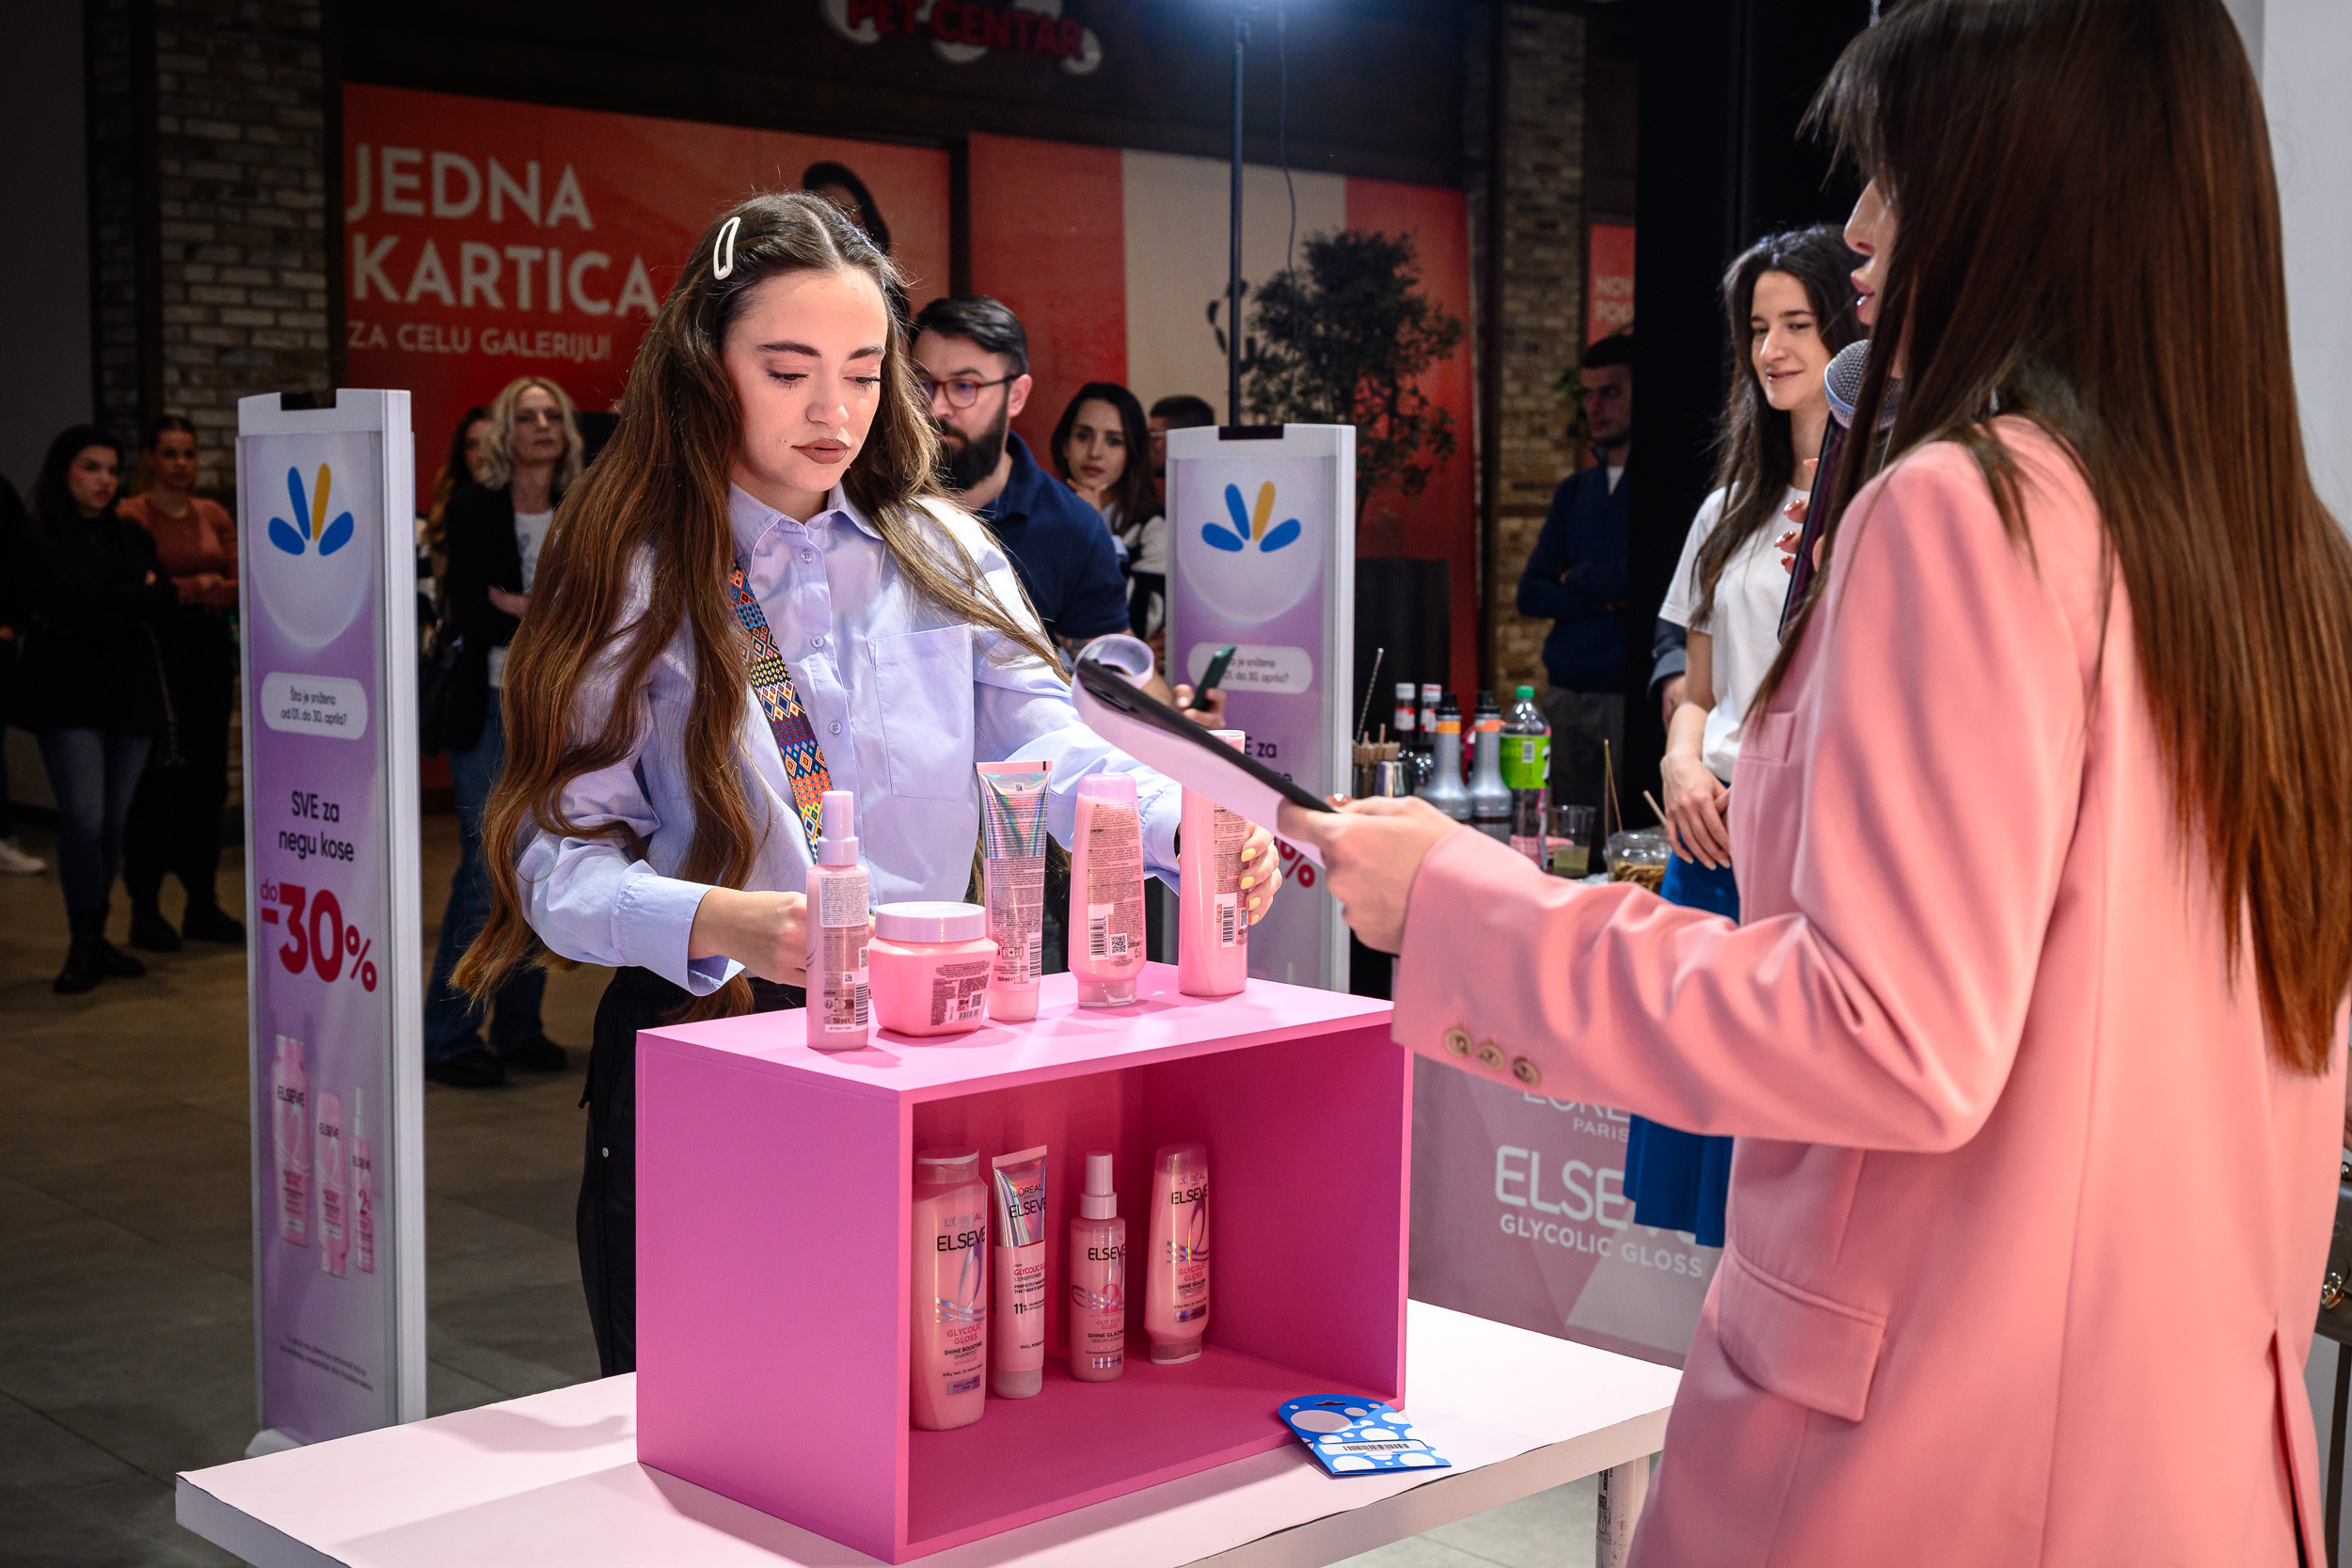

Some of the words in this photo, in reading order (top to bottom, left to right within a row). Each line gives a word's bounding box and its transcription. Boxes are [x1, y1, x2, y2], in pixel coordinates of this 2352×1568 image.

[849, 0, 918, 35] PET
[931, 2, 1083, 59] CENTAR
[345, 143, 594, 230] JEDNA
[351, 232, 660, 318] KARTICA
[347, 321, 388, 349] ZA
[397, 323, 469, 355] CELU
[480, 328, 612, 364] GALERIJU!
[1257, 742, 1277, 758] za
[292, 790, 319, 819] SVE
[323, 802, 339, 823] za
[278, 831, 316, 860] negu
[321, 832, 355, 863] kose
[261, 879, 278, 902] do
[1573, 1117, 1629, 1143] PARIS
[1171, 1183, 1207, 1205] ELSEVE
[1494, 1145, 1696, 1246] ELSE
[937, 1226, 986, 1252] ELSEVE
[1500, 1213, 1613, 1258] GLYCOLIC
[1620, 1243, 1703, 1278] GLOSS
[1088, 1243, 1125, 1260] ELSEVE
[1014, 1264, 1040, 1275] GLYCOLIC
[1184, 1271, 1202, 1281] GLOSS
[947, 1323, 982, 1337] GLYCOLIC
[954, 1333, 977, 1345] GLOSS
[945, 1347, 961, 1355] SHINE
[954, 1349, 977, 1360] SHAMPOO
